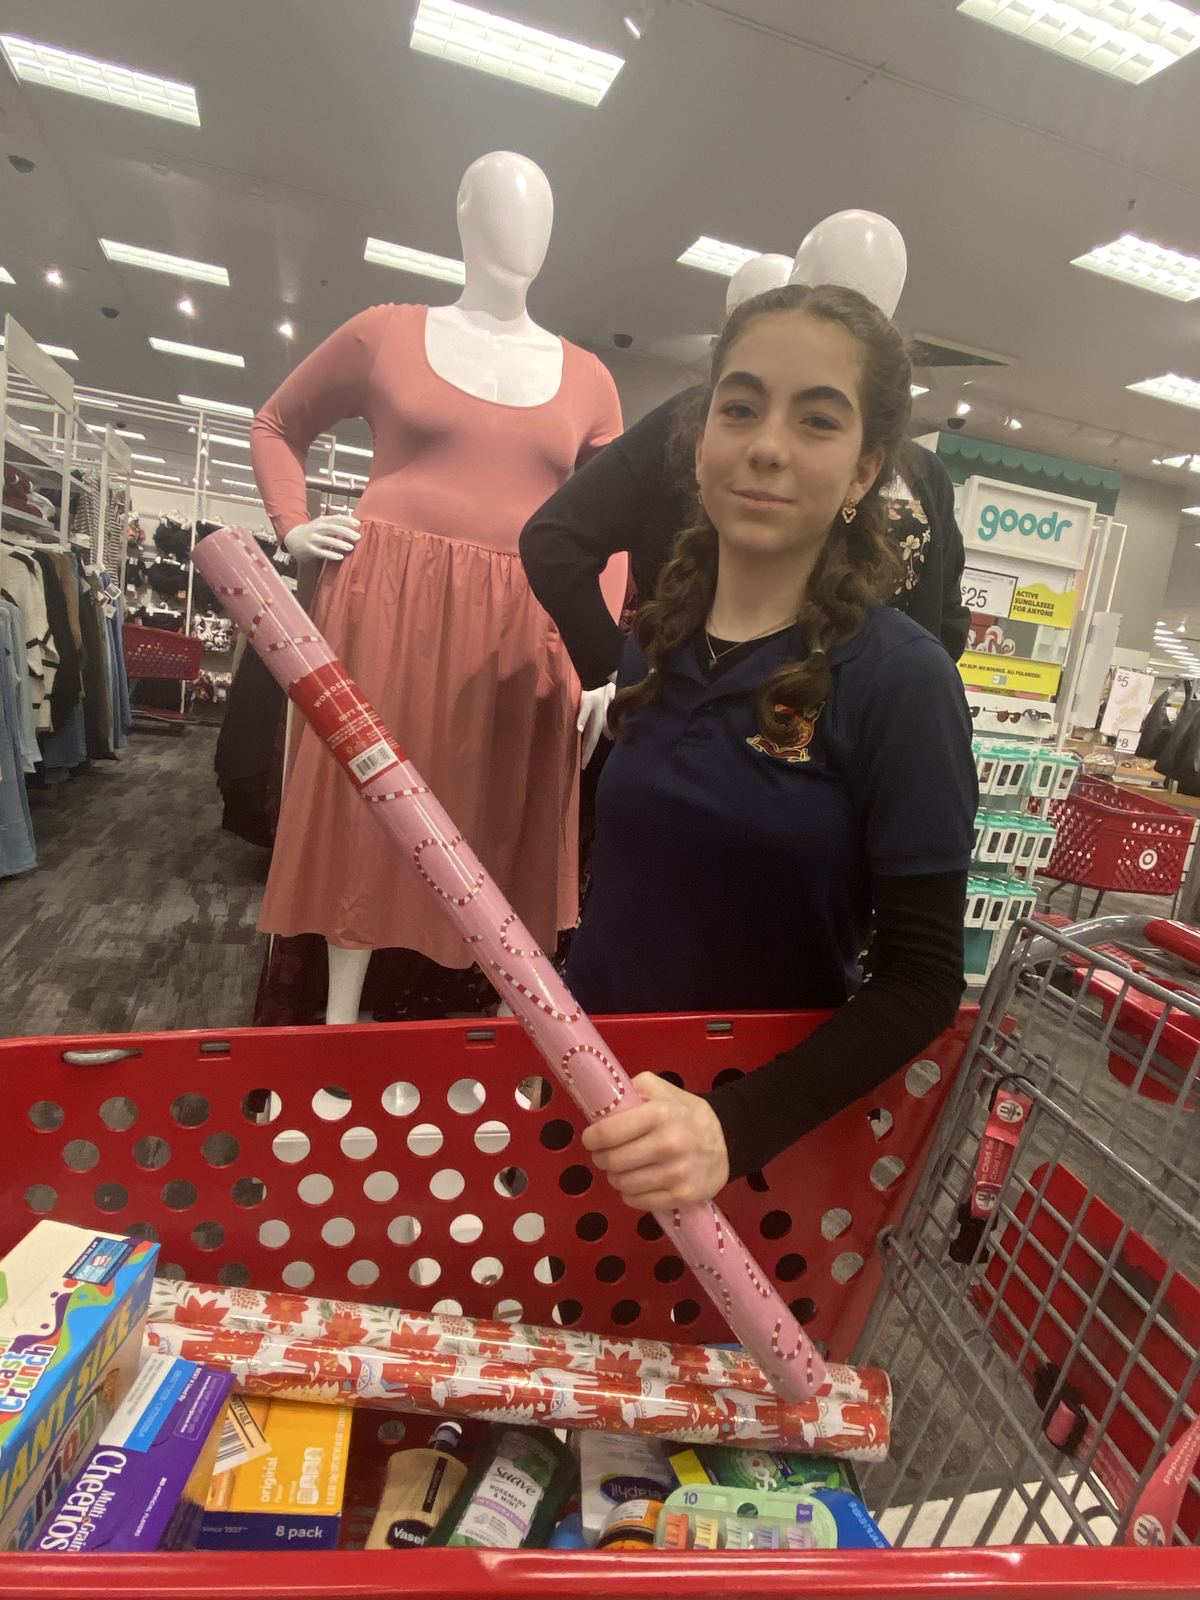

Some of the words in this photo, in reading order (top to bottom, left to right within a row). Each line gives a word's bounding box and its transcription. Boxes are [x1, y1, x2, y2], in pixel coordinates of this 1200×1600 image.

[978, 505, 1072, 542] goodr
[961, 586, 987, 608] $25
[1014, 597, 1055, 611] SUNGLASSES
[1016, 590, 1039, 600] ACTIVE
[1013, 605, 1026, 614] FOR
[1027, 606, 1054, 618] ANYONE
[1117, 674, 1129, 687] $5
[0, 1344, 56, 1412] Crunch
[260, 1456, 278, 1503] original
[497, 1465, 536, 1496] Suave
[40, 1451, 127, 1551] Cheerios
[92, 1489, 115, 1518] Multi
[489, 1484, 527, 1508] ROSEMARY
[501, 1495, 519, 1510] MINT
[683, 1491, 698, 1505] 10
[73, 1523, 96, 1552] Grain
[275, 1525, 286, 1537] 8
[288, 1525, 325, 1541] pack
